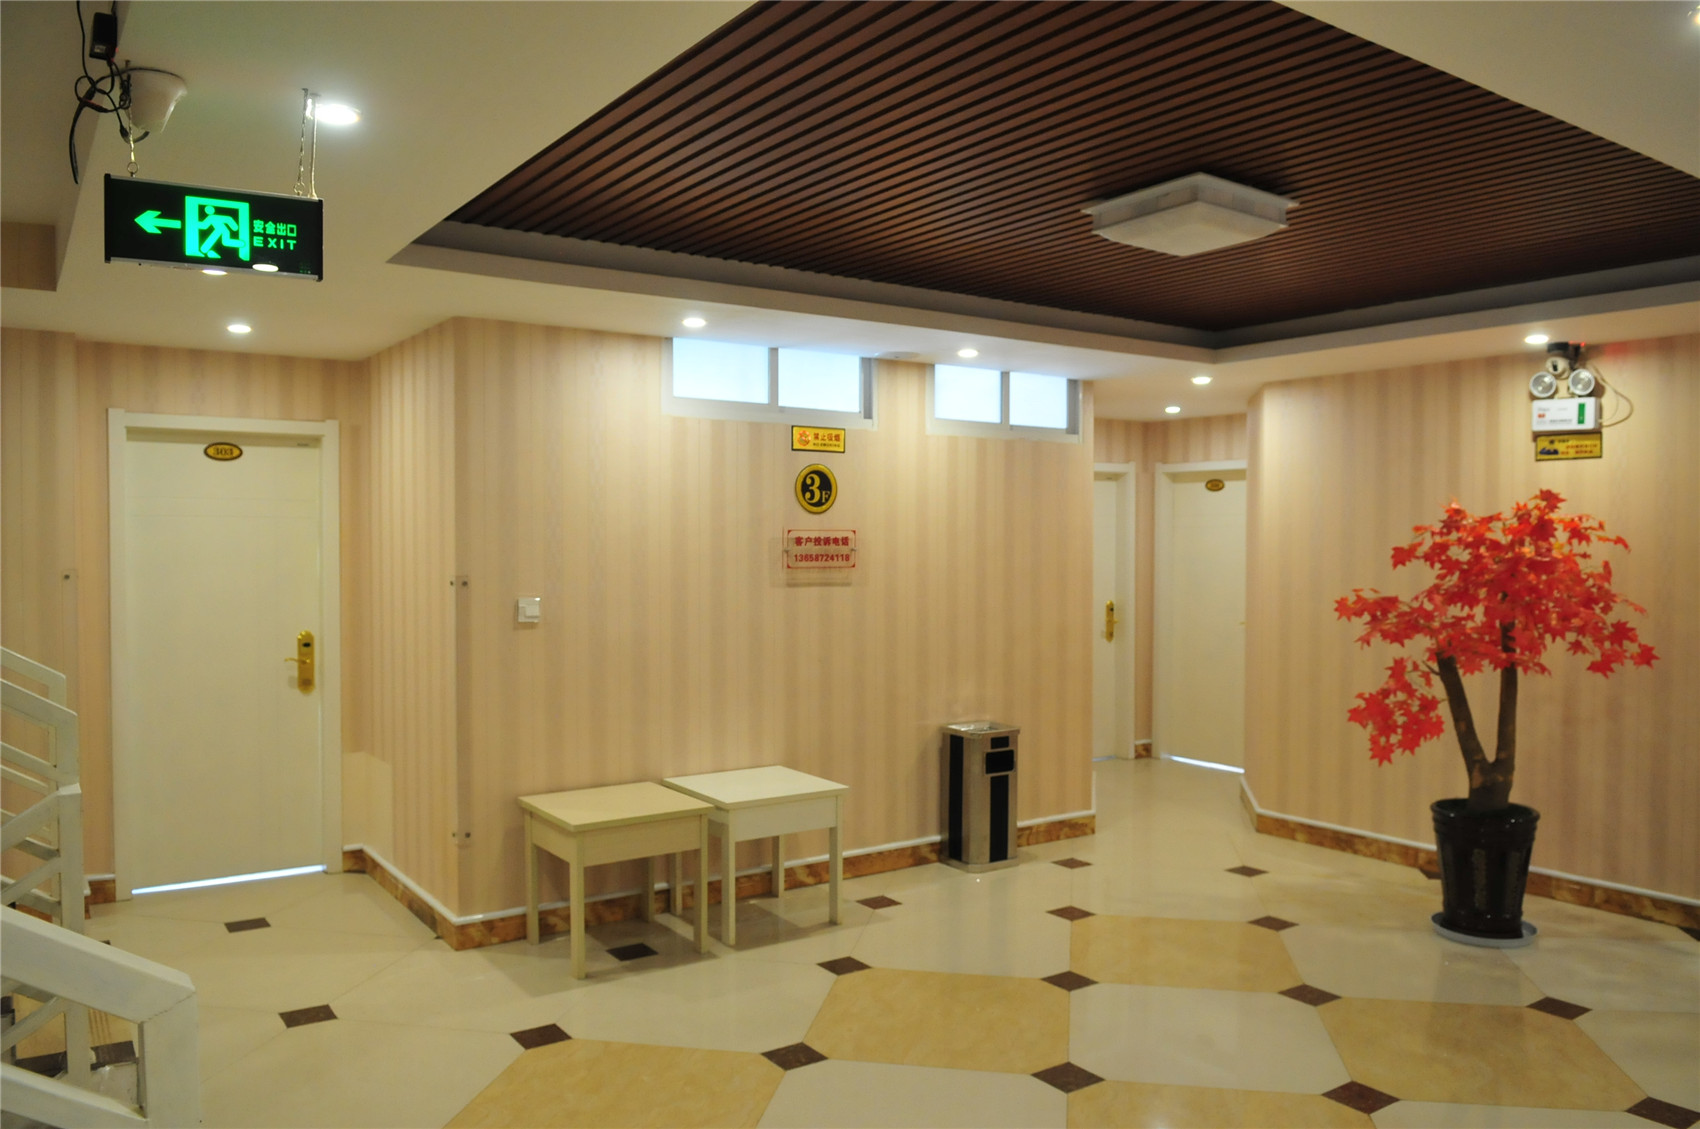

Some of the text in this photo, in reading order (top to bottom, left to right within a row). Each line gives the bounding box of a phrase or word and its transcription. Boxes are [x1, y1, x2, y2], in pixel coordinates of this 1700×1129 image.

[253, 219, 297, 237] 安全出口
[253, 236, 297, 250] EXIT
[794, 536, 850, 547] 客户投诉电话
